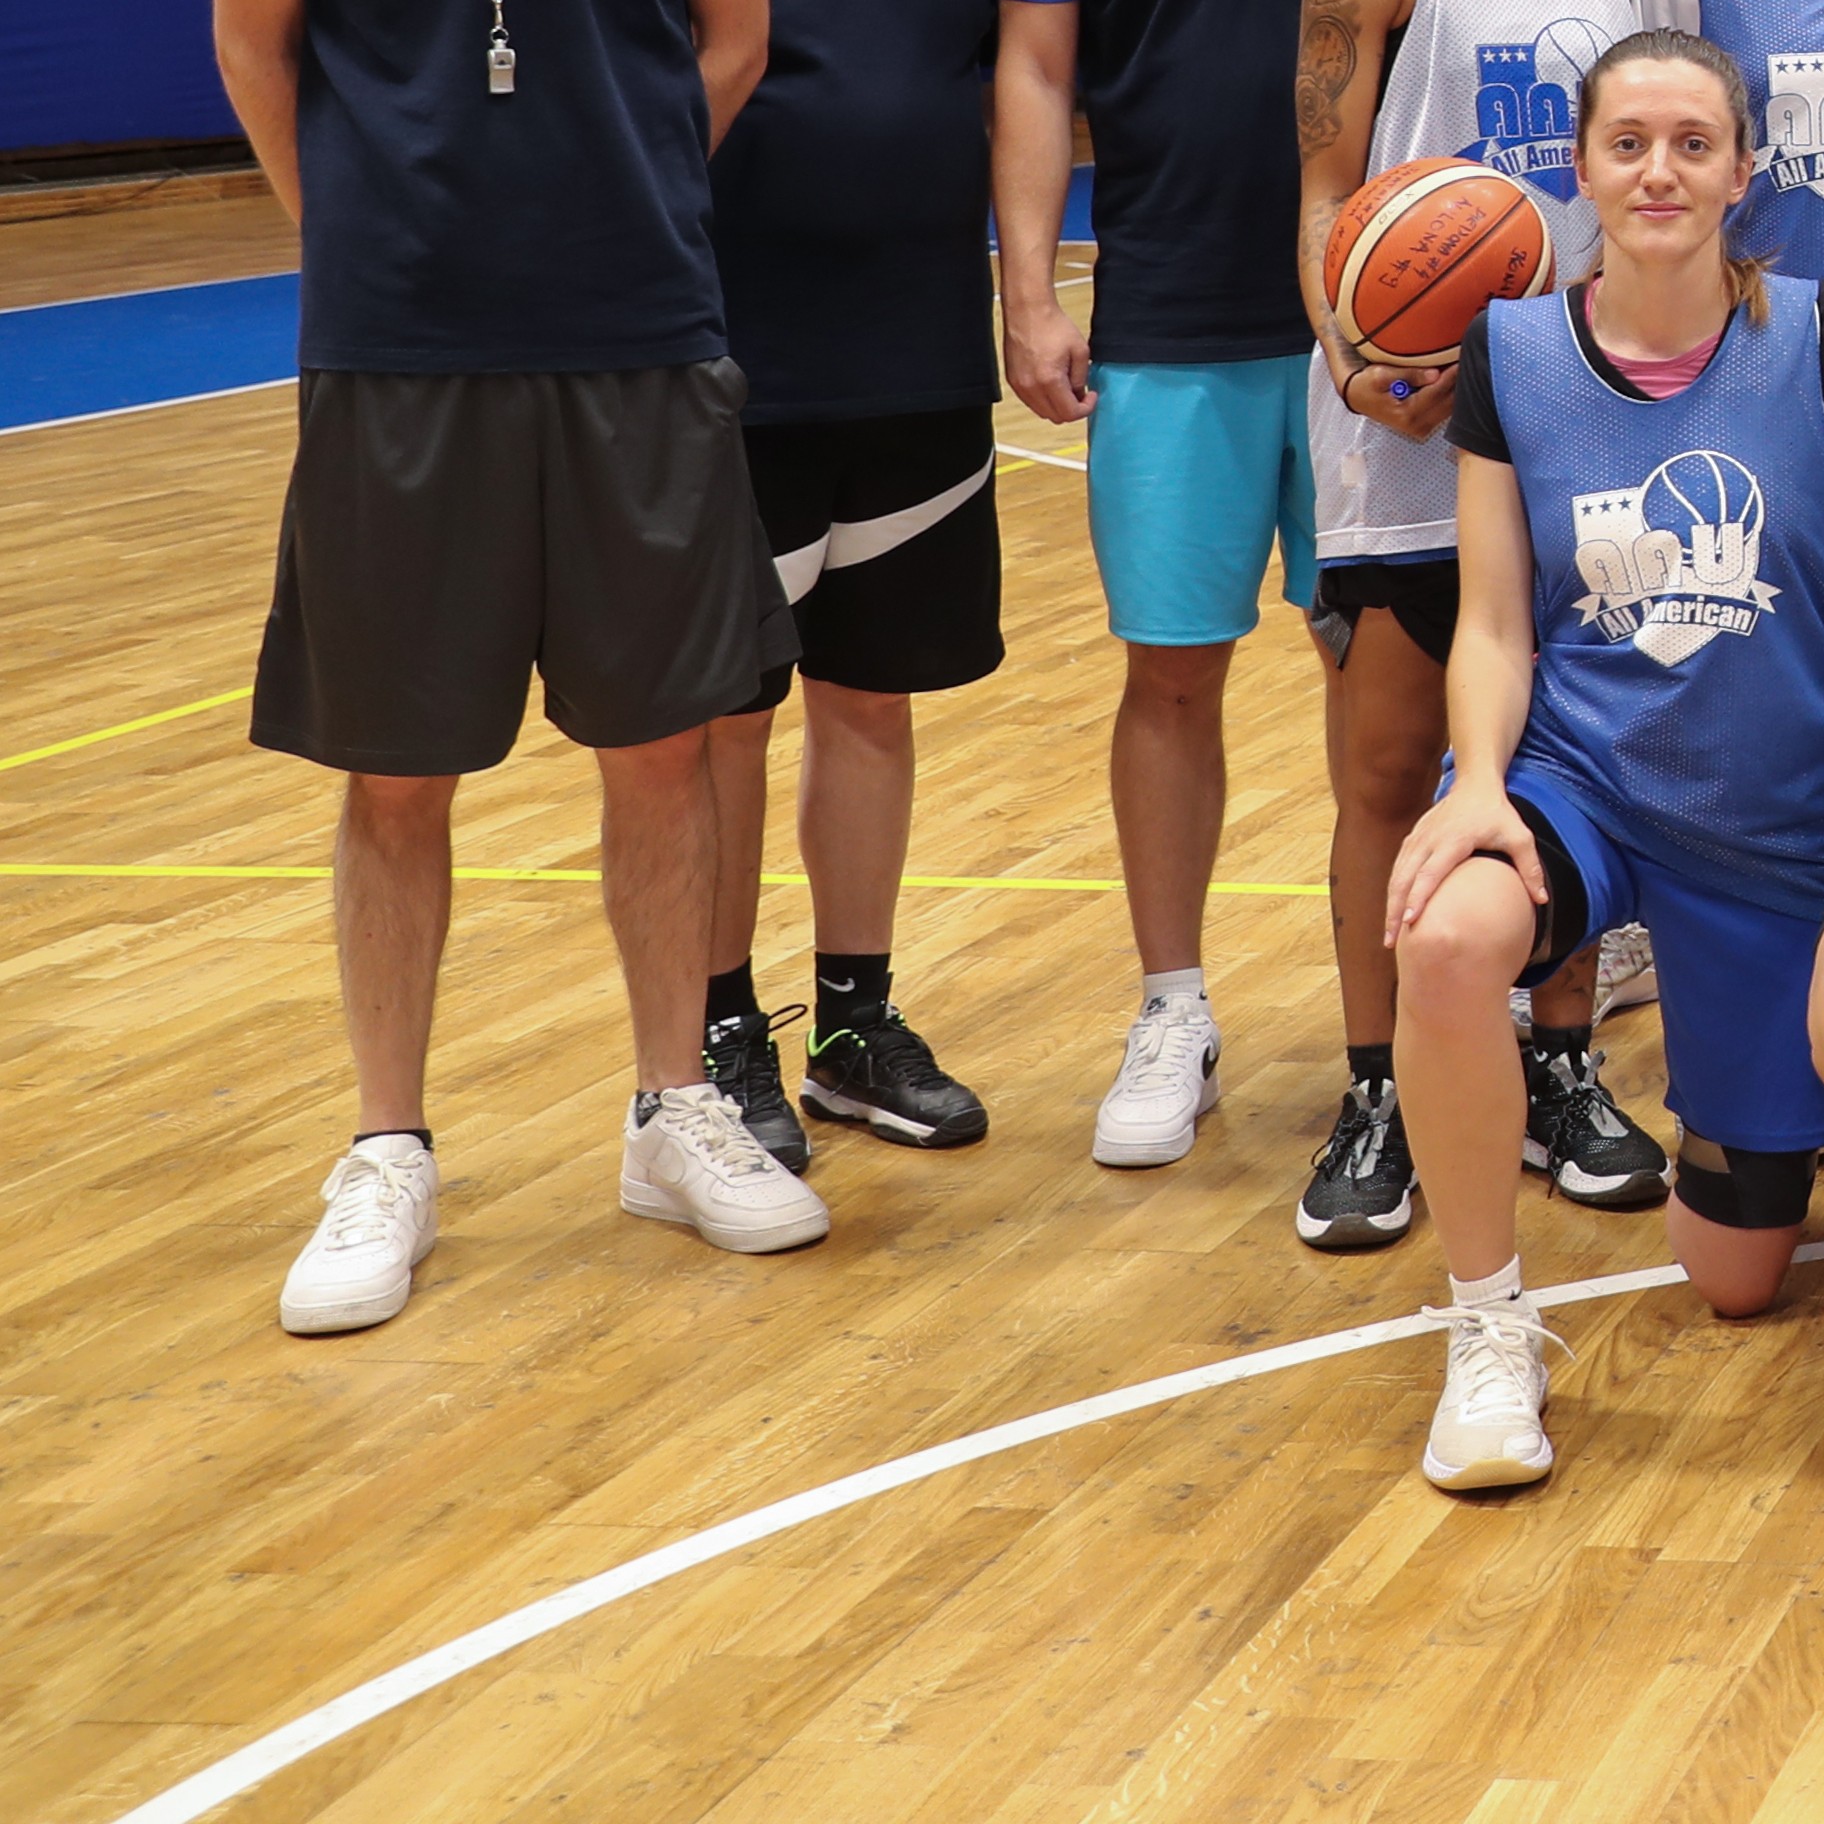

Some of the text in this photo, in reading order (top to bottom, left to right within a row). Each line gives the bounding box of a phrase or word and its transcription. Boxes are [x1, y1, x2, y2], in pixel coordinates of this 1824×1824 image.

[1475, 82, 1581, 140] AA
[1490, 150, 1523, 177] All
[1776, 154, 1808, 185] All
[1574, 522, 1761, 597] AAU
[1605, 594, 1754, 641] All American
